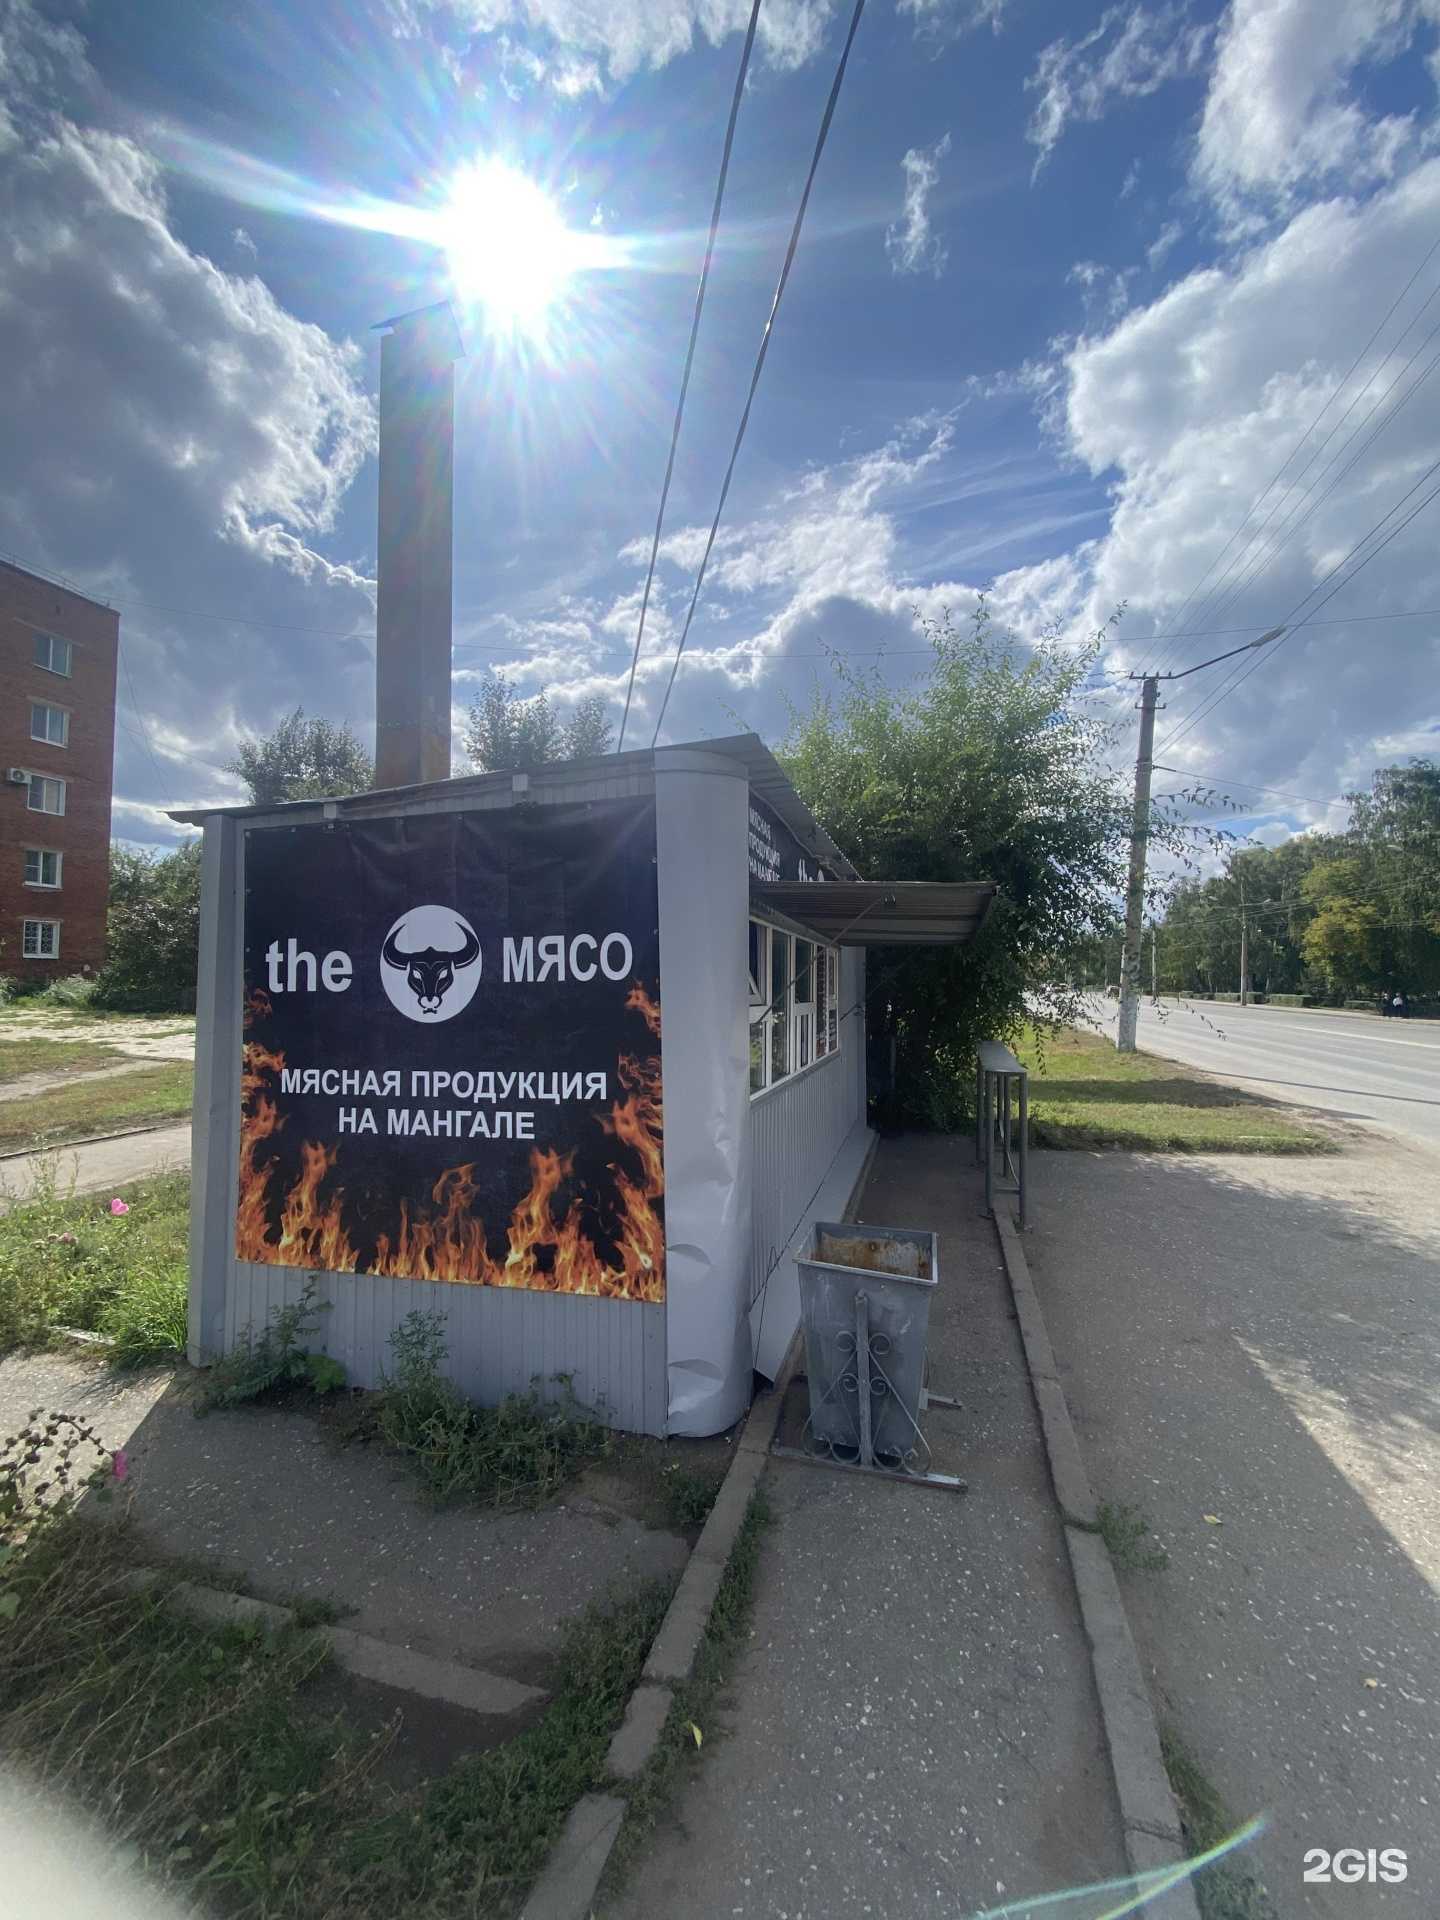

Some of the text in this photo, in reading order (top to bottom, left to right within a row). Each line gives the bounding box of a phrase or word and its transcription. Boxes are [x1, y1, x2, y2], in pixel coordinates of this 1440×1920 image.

[265, 932, 633, 993] the МЯСО
[281, 1068, 607, 1104] МЯСНАЯ ПРОДУКЦИЯ
[338, 1108, 535, 1140] НА МАНГАЛЕ
